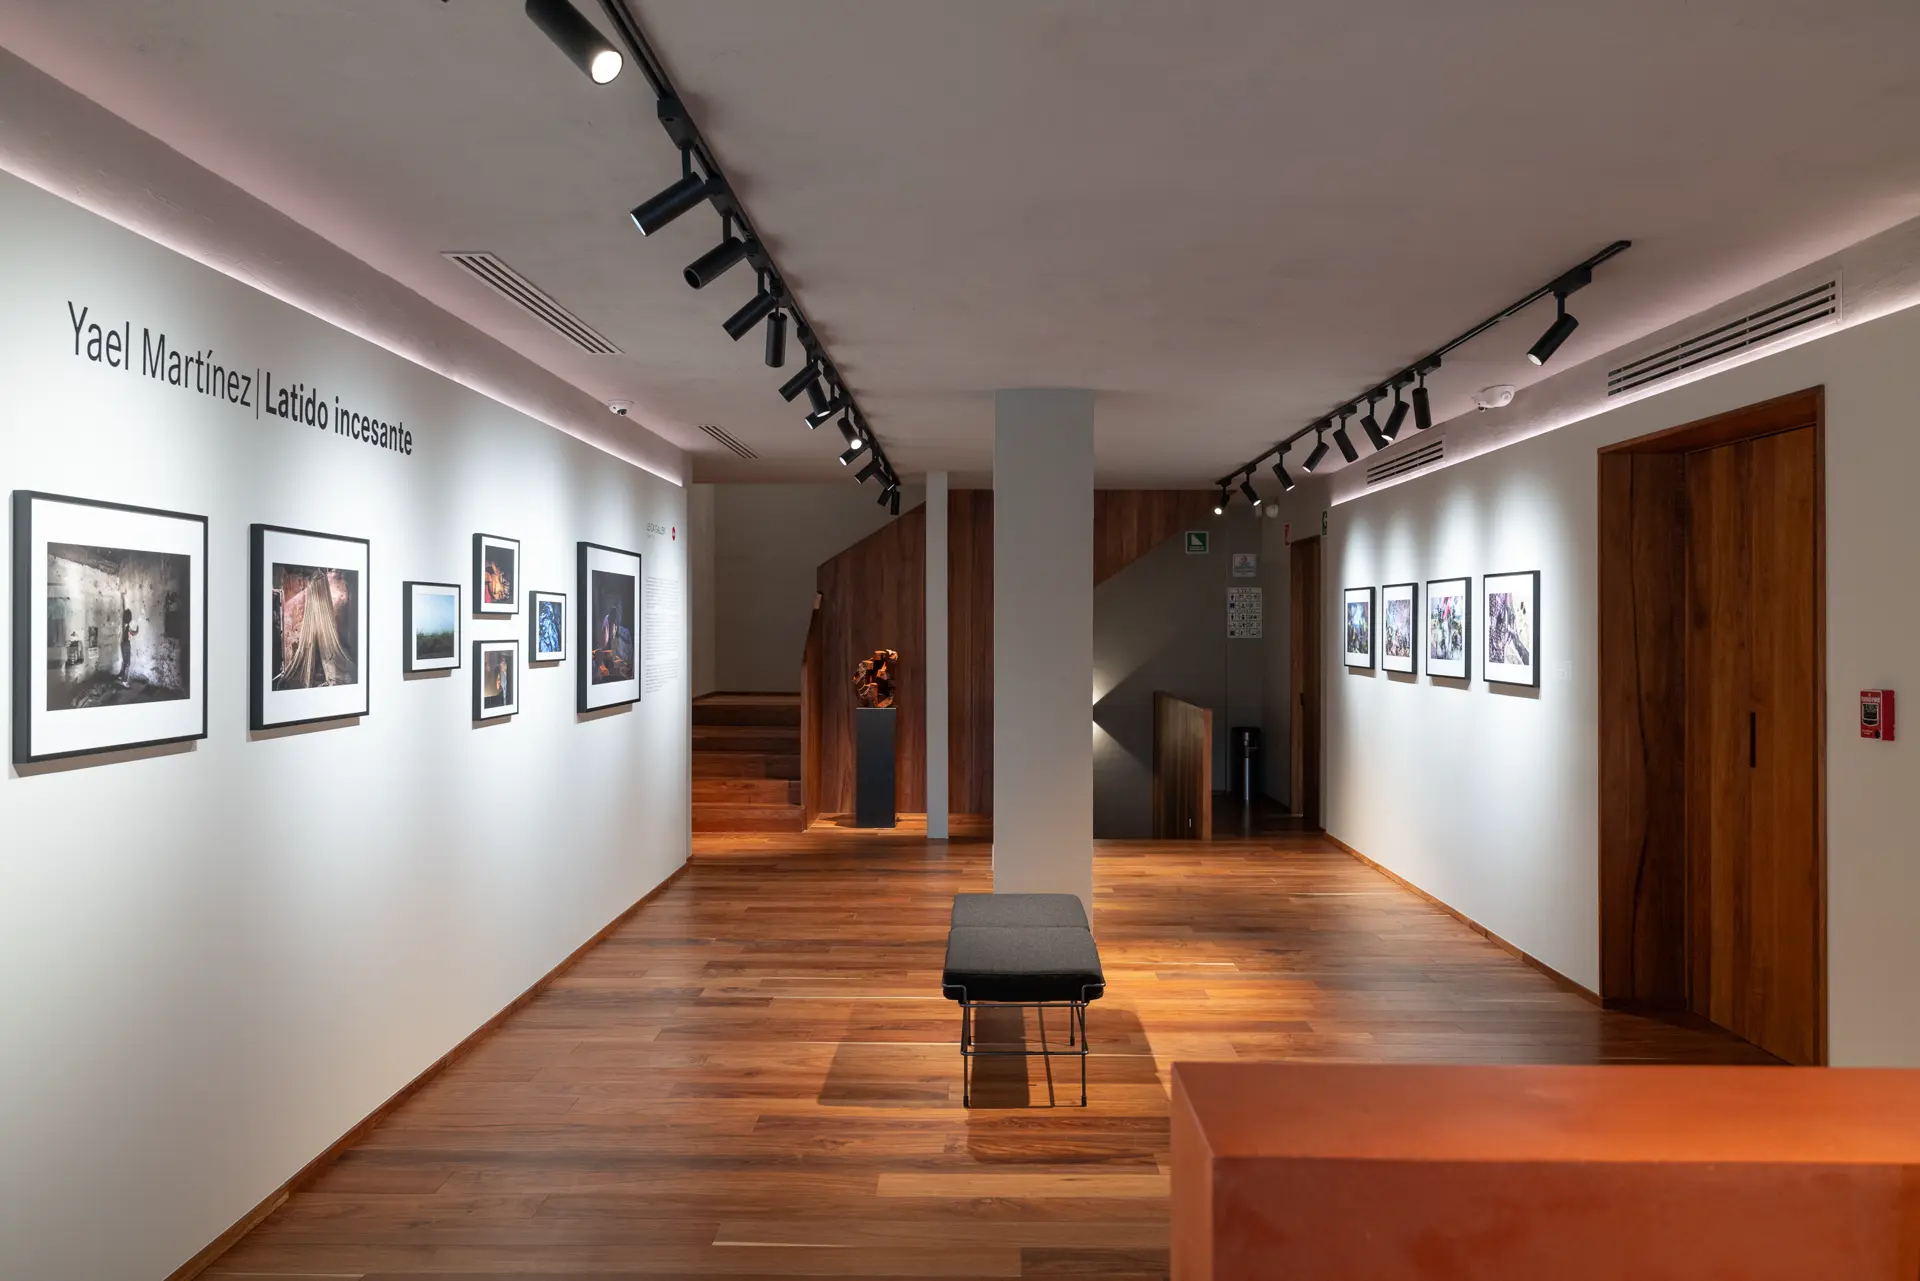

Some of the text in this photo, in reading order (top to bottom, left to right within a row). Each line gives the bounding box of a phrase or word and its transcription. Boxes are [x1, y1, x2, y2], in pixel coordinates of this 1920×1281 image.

[67, 300, 413, 456] Yael Martínez Latido incesante
